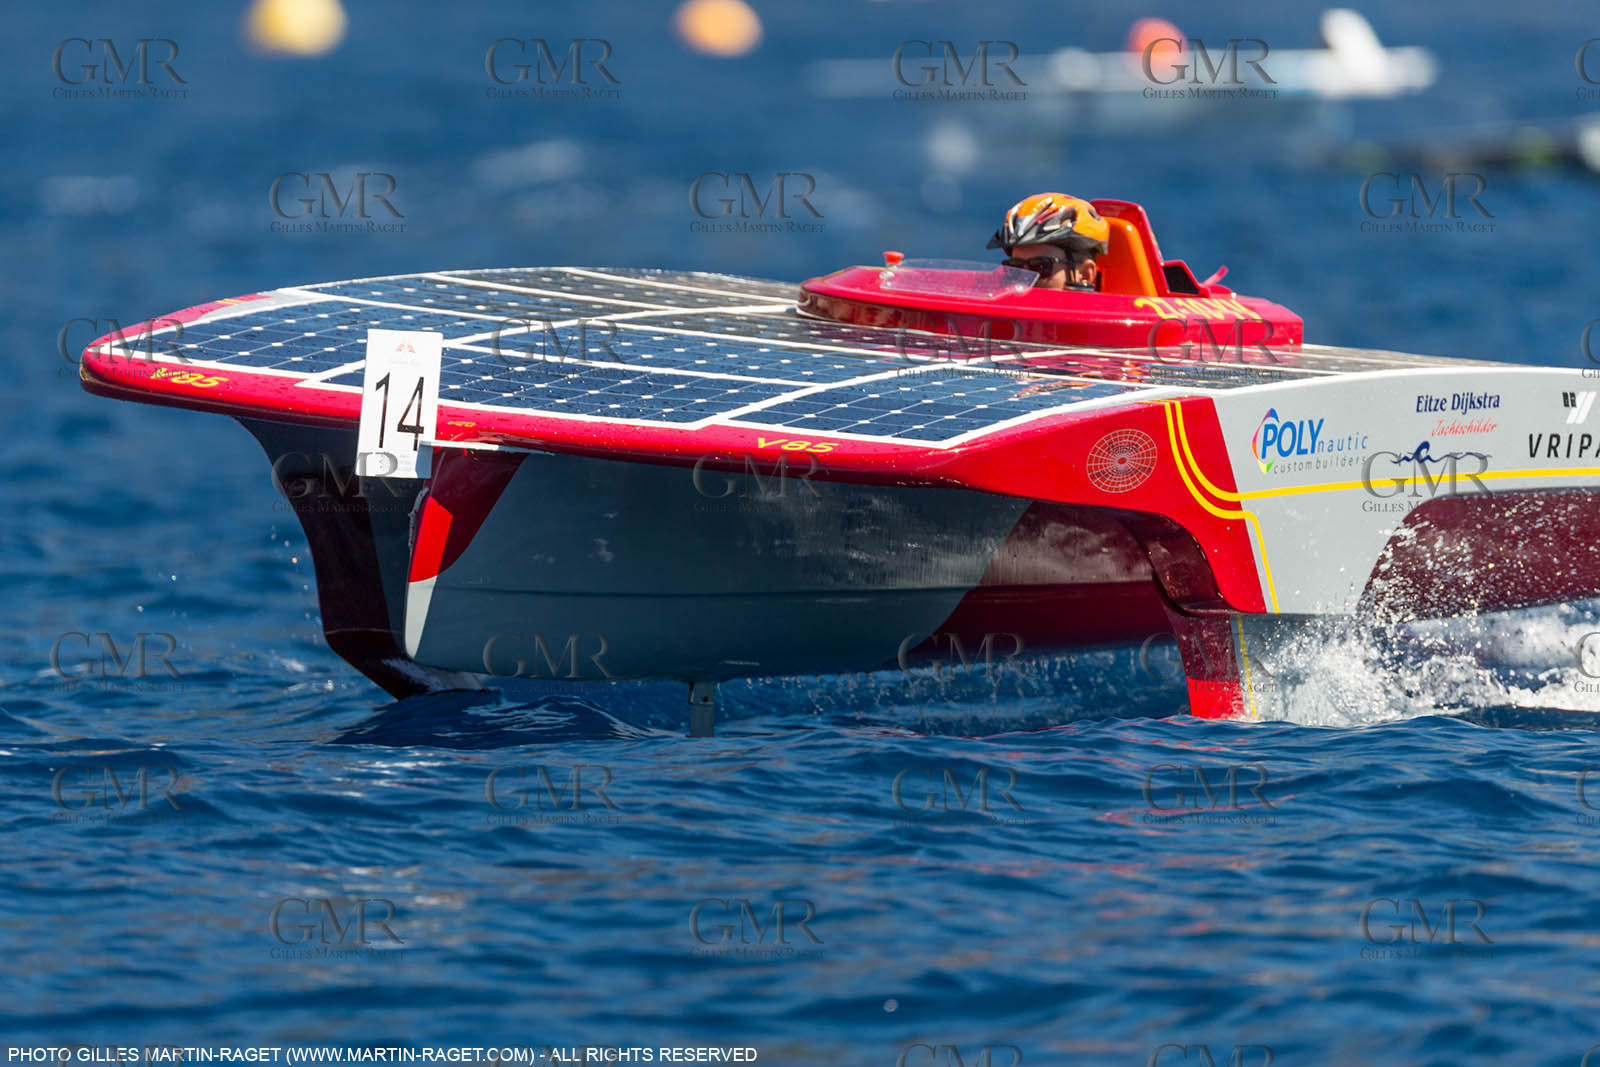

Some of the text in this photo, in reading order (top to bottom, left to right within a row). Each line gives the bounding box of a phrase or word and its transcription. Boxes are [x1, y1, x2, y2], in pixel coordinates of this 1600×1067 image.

[375, 372, 425, 451] 14
[1416, 392, 1501, 415] Eitze Dijkstra
[757, 437, 839, 453] V85
[1528, 432, 1600, 459] VRIP
